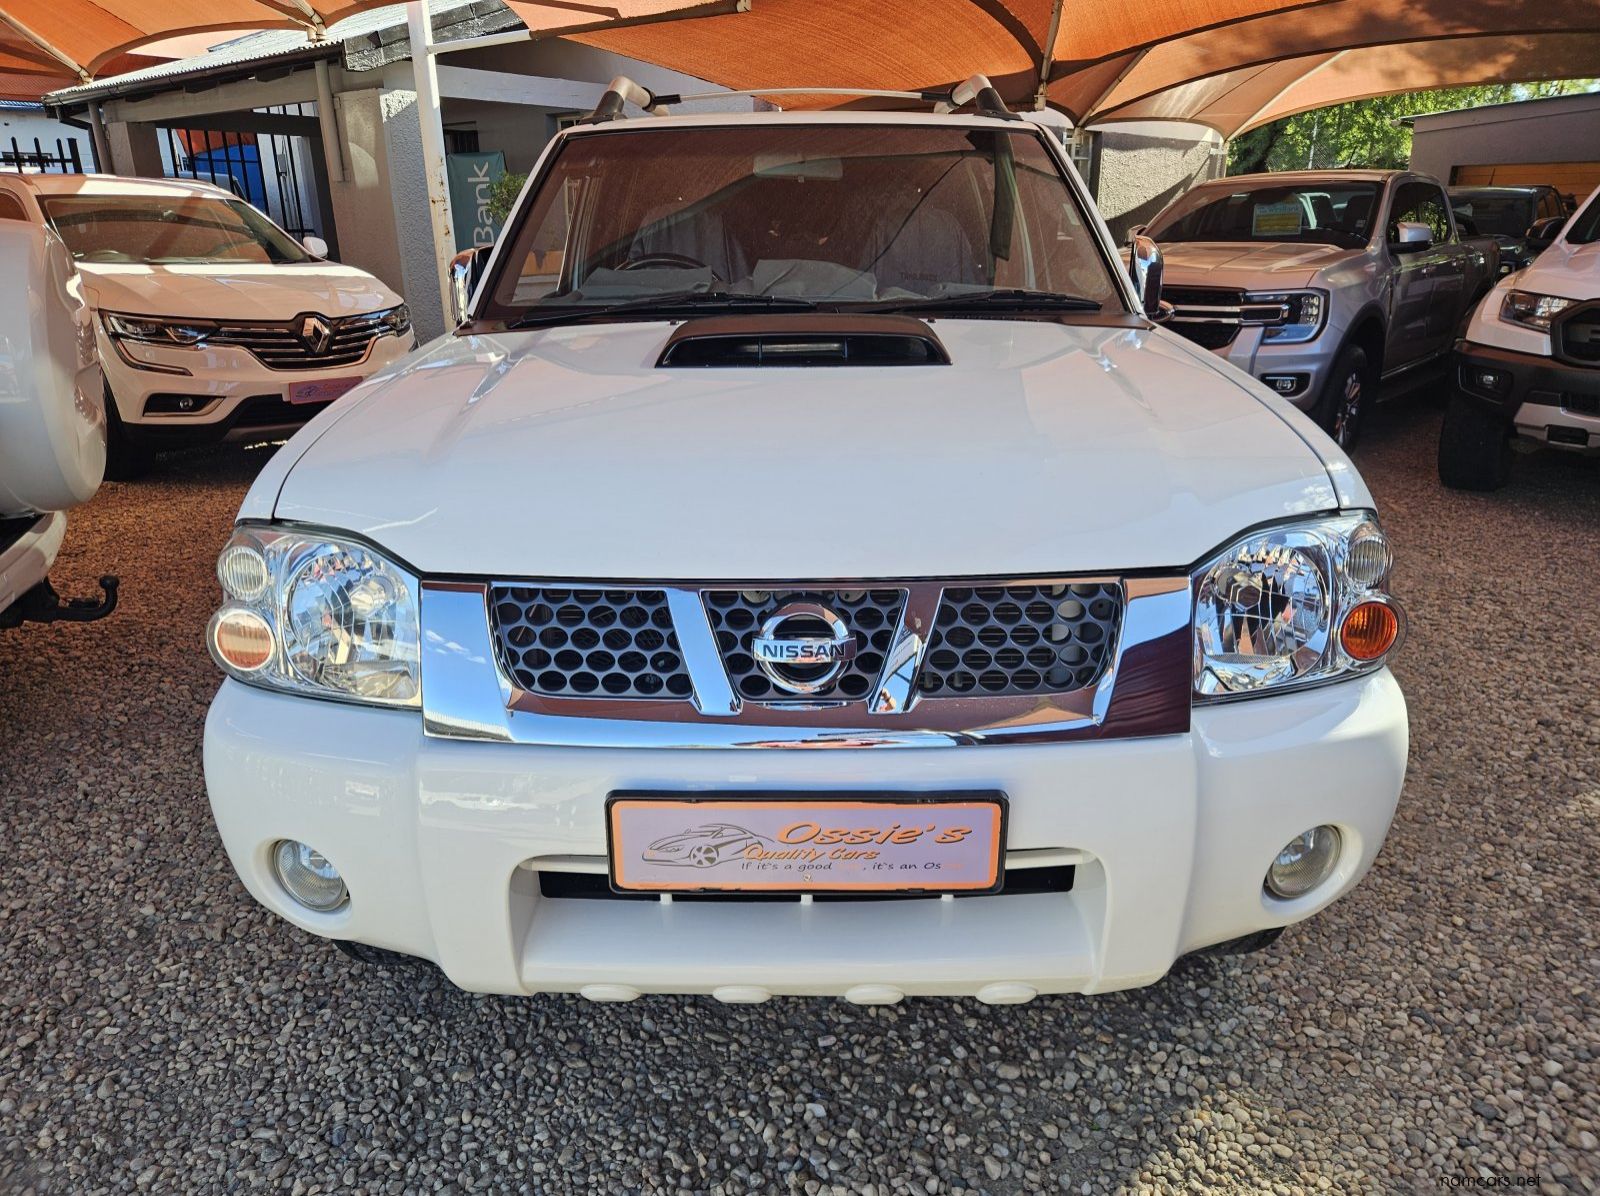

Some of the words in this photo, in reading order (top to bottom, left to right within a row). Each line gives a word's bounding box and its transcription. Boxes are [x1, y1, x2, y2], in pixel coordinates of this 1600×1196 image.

[467, 161, 495, 247] Bank
[762, 644, 845, 659] NISSAN
[777, 822, 972, 845] Ossie's
[743, 842, 826, 863] Quality
[828, 846, 880, 860] Cars
[757, 862, 779, 871] it's
[798, 862, 833, 873] good
